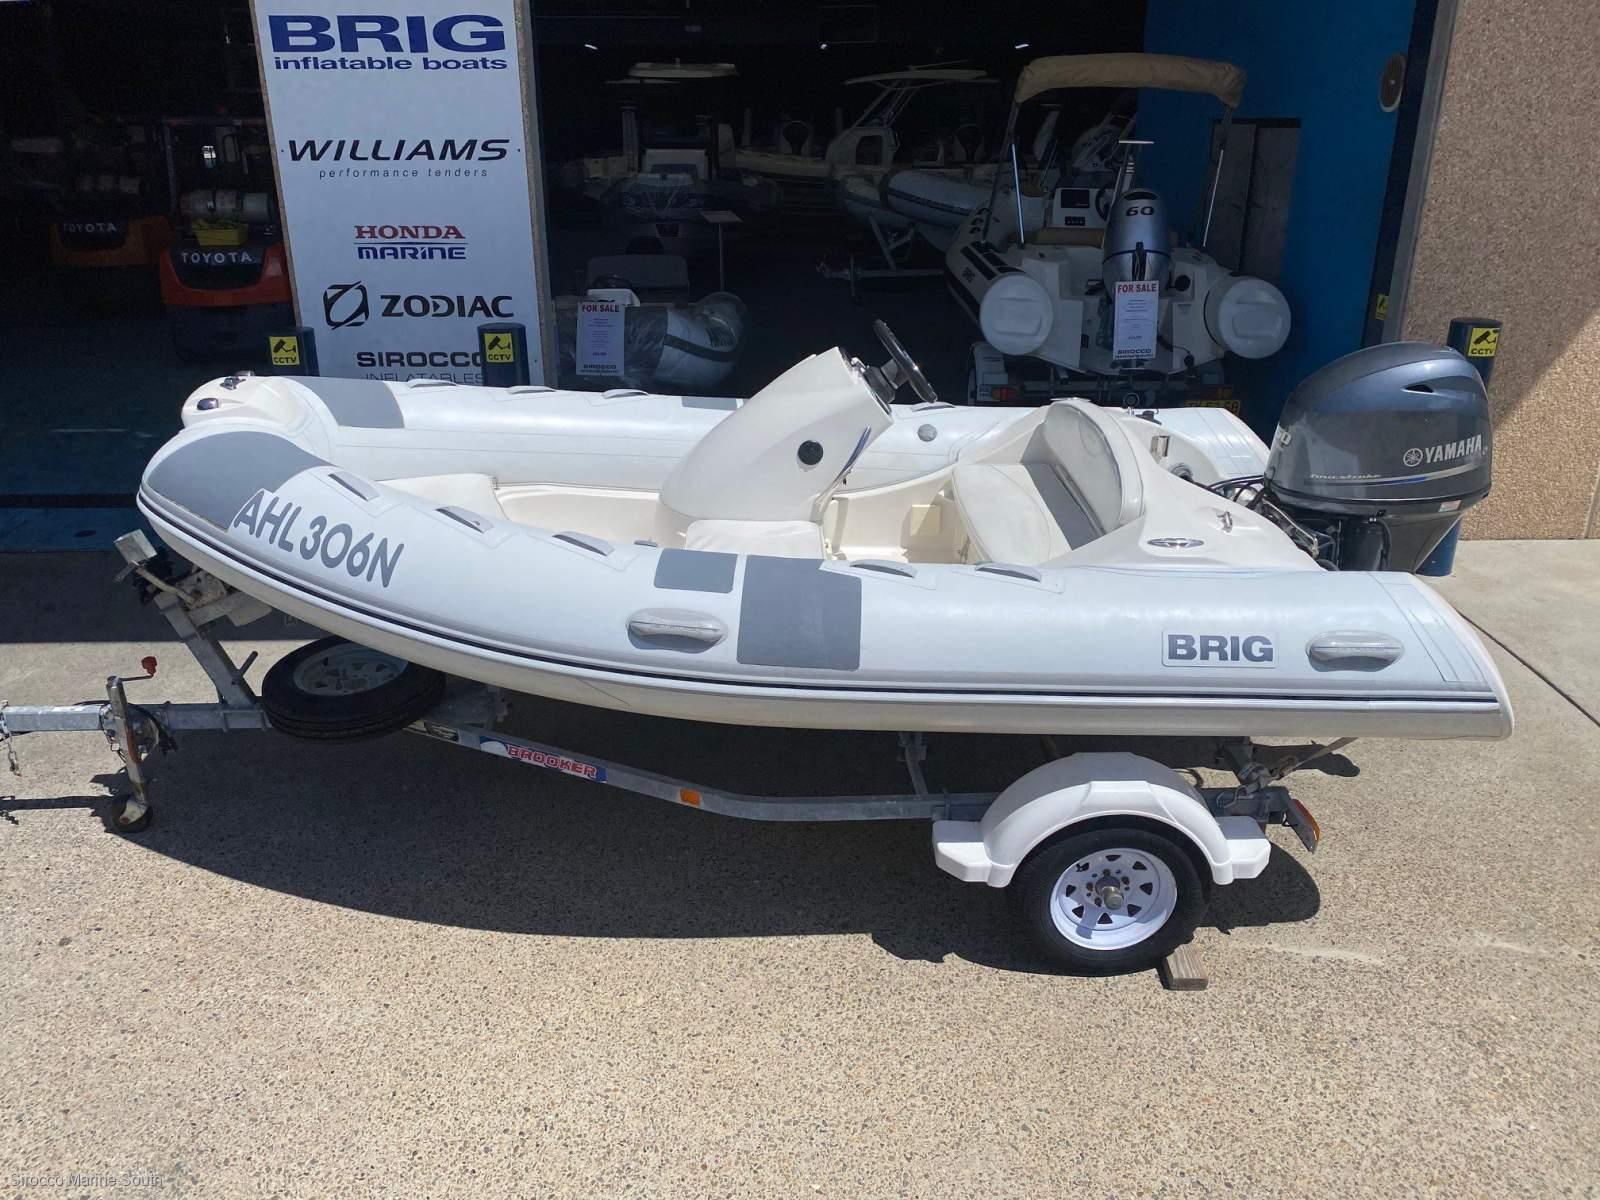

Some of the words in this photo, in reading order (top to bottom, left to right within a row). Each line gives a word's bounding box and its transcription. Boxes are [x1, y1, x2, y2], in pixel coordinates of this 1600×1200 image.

[268, 15, 506, 53] BRIG
[275, 56, 412, 70] inflatable
[422, 57, 508, 70] boats
[288, 139, 510, 161] WILLIAMS
[319, 168, 418, 180] performance
[428, 167, 488, 178] tenders
[1126, 205, 1155, 217] 60
[62, 222, 118, 233] TOYOTA
[354, 225, 466, 239] HONDA
[181, 252, 252, 264] TOYOTA
[358, 246, 467, 260] MARINE
[1117, 284, 1134, 293] FOR
[1136, 283, 1157, 293] SALE
[380, 295, 515, 318] ZODIAC
[582, 304, 597, 312] FOR
[600, 304, 619, 312] SALE
[273, 356, 297, 364] CCTV
[488, 353, 512, 361] CCTV
[1425, 434, 1482, 464] YAMAHA
[234, 489, 405, 588] AHL306N
[1168, 634, 1274, 662] BRIG
[507, 744, 598, 779] BROOKER
